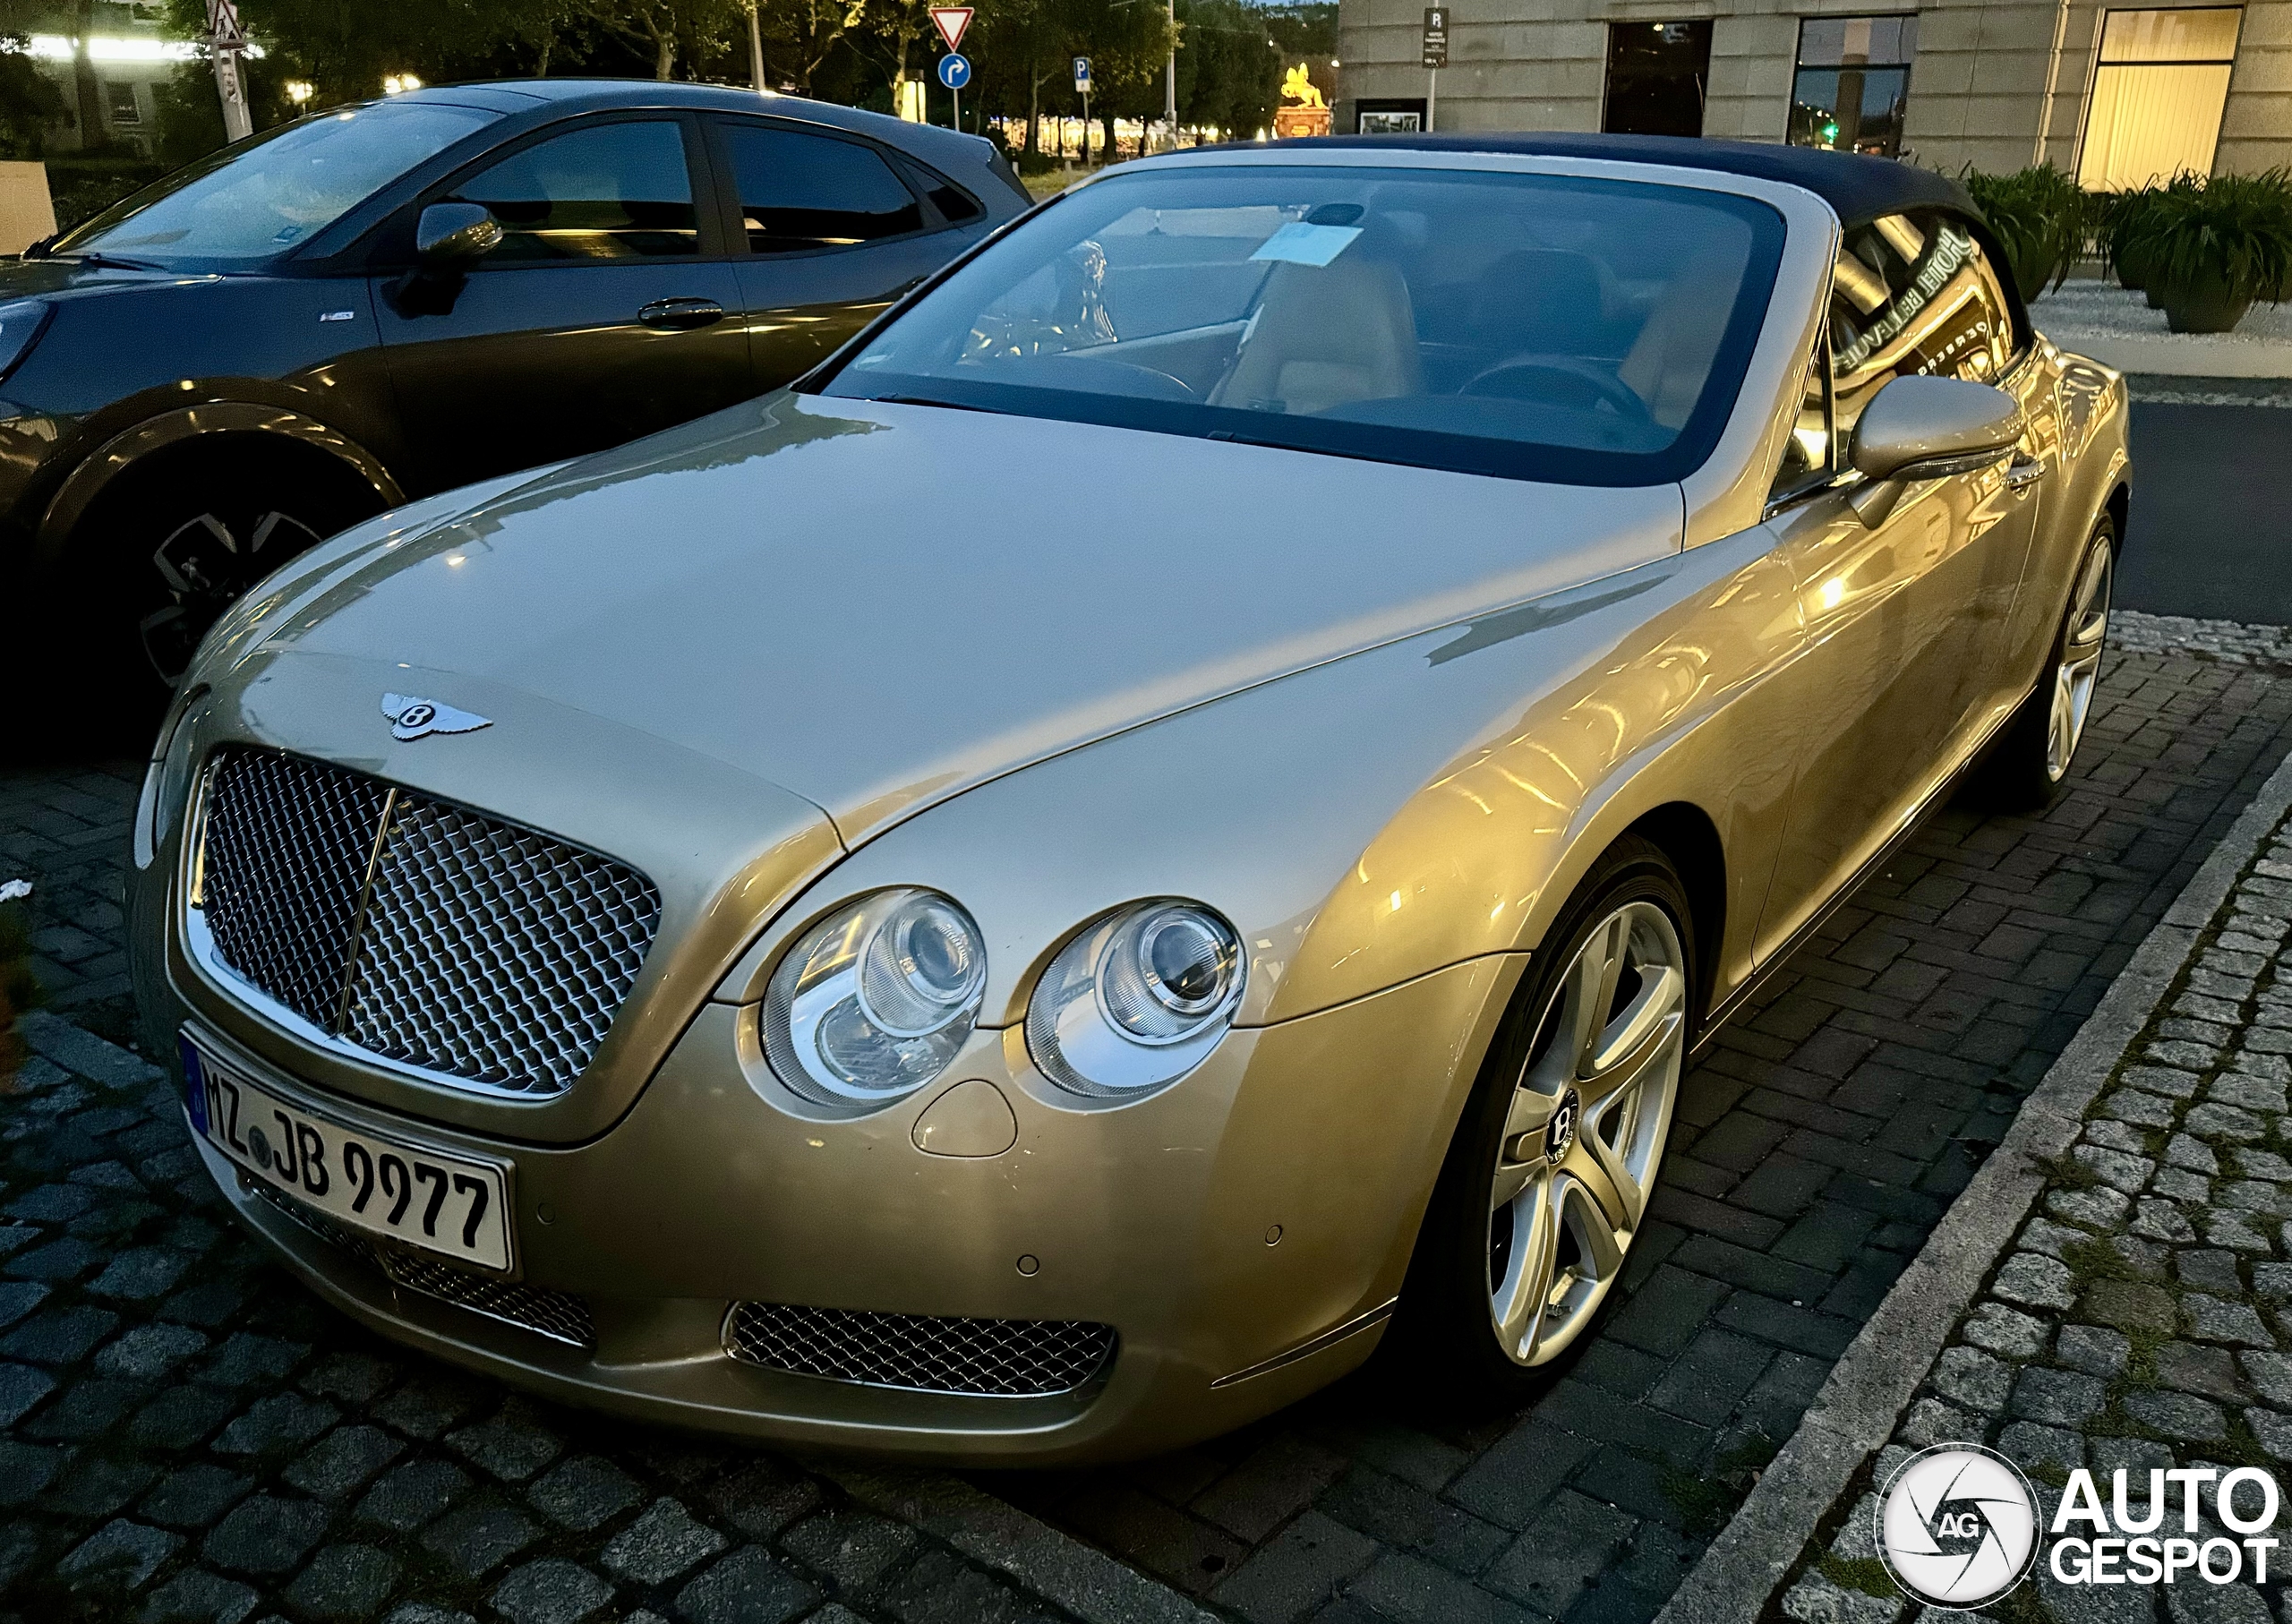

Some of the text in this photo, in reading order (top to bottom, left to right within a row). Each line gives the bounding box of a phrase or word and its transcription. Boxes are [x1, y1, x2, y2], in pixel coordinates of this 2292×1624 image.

[1076, 60, 1086, 78] P
[1553, 1107, 1570, 1145] B
[201, 1062, 488, 1248] MZ JB 9977
